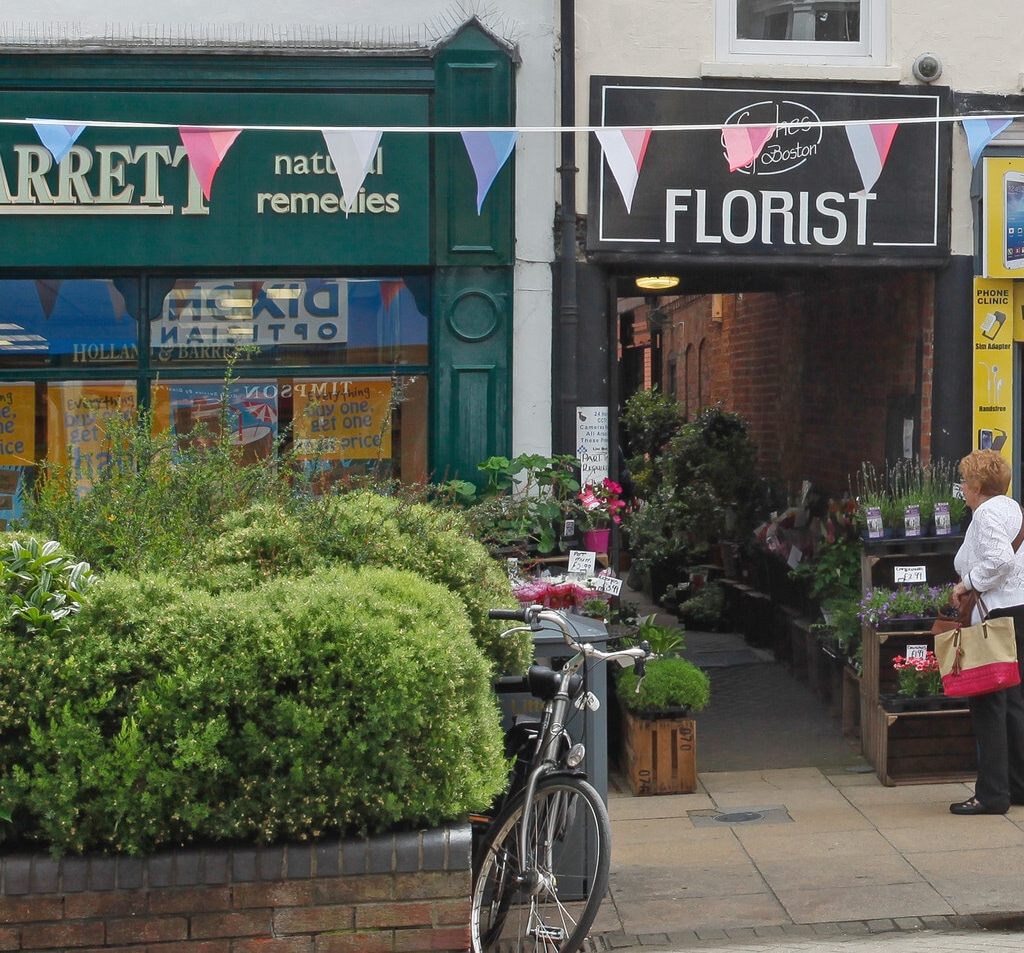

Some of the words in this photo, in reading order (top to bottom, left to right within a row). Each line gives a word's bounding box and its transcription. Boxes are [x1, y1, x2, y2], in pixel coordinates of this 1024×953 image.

[761, 142, 817, 165] Boston
[665, 188, 877, 246] FLORIST
[977, 297, 1009, 305] CLINIC
[73, 343, 153, 362] HOLLAN
[987, 343, 1011, 351] Adapter
[307, 387, 371, 402] Everything
[311, 417, 337, 433] get
[343, 415, 373, 429] one
[70, 427, 99, 444] get
